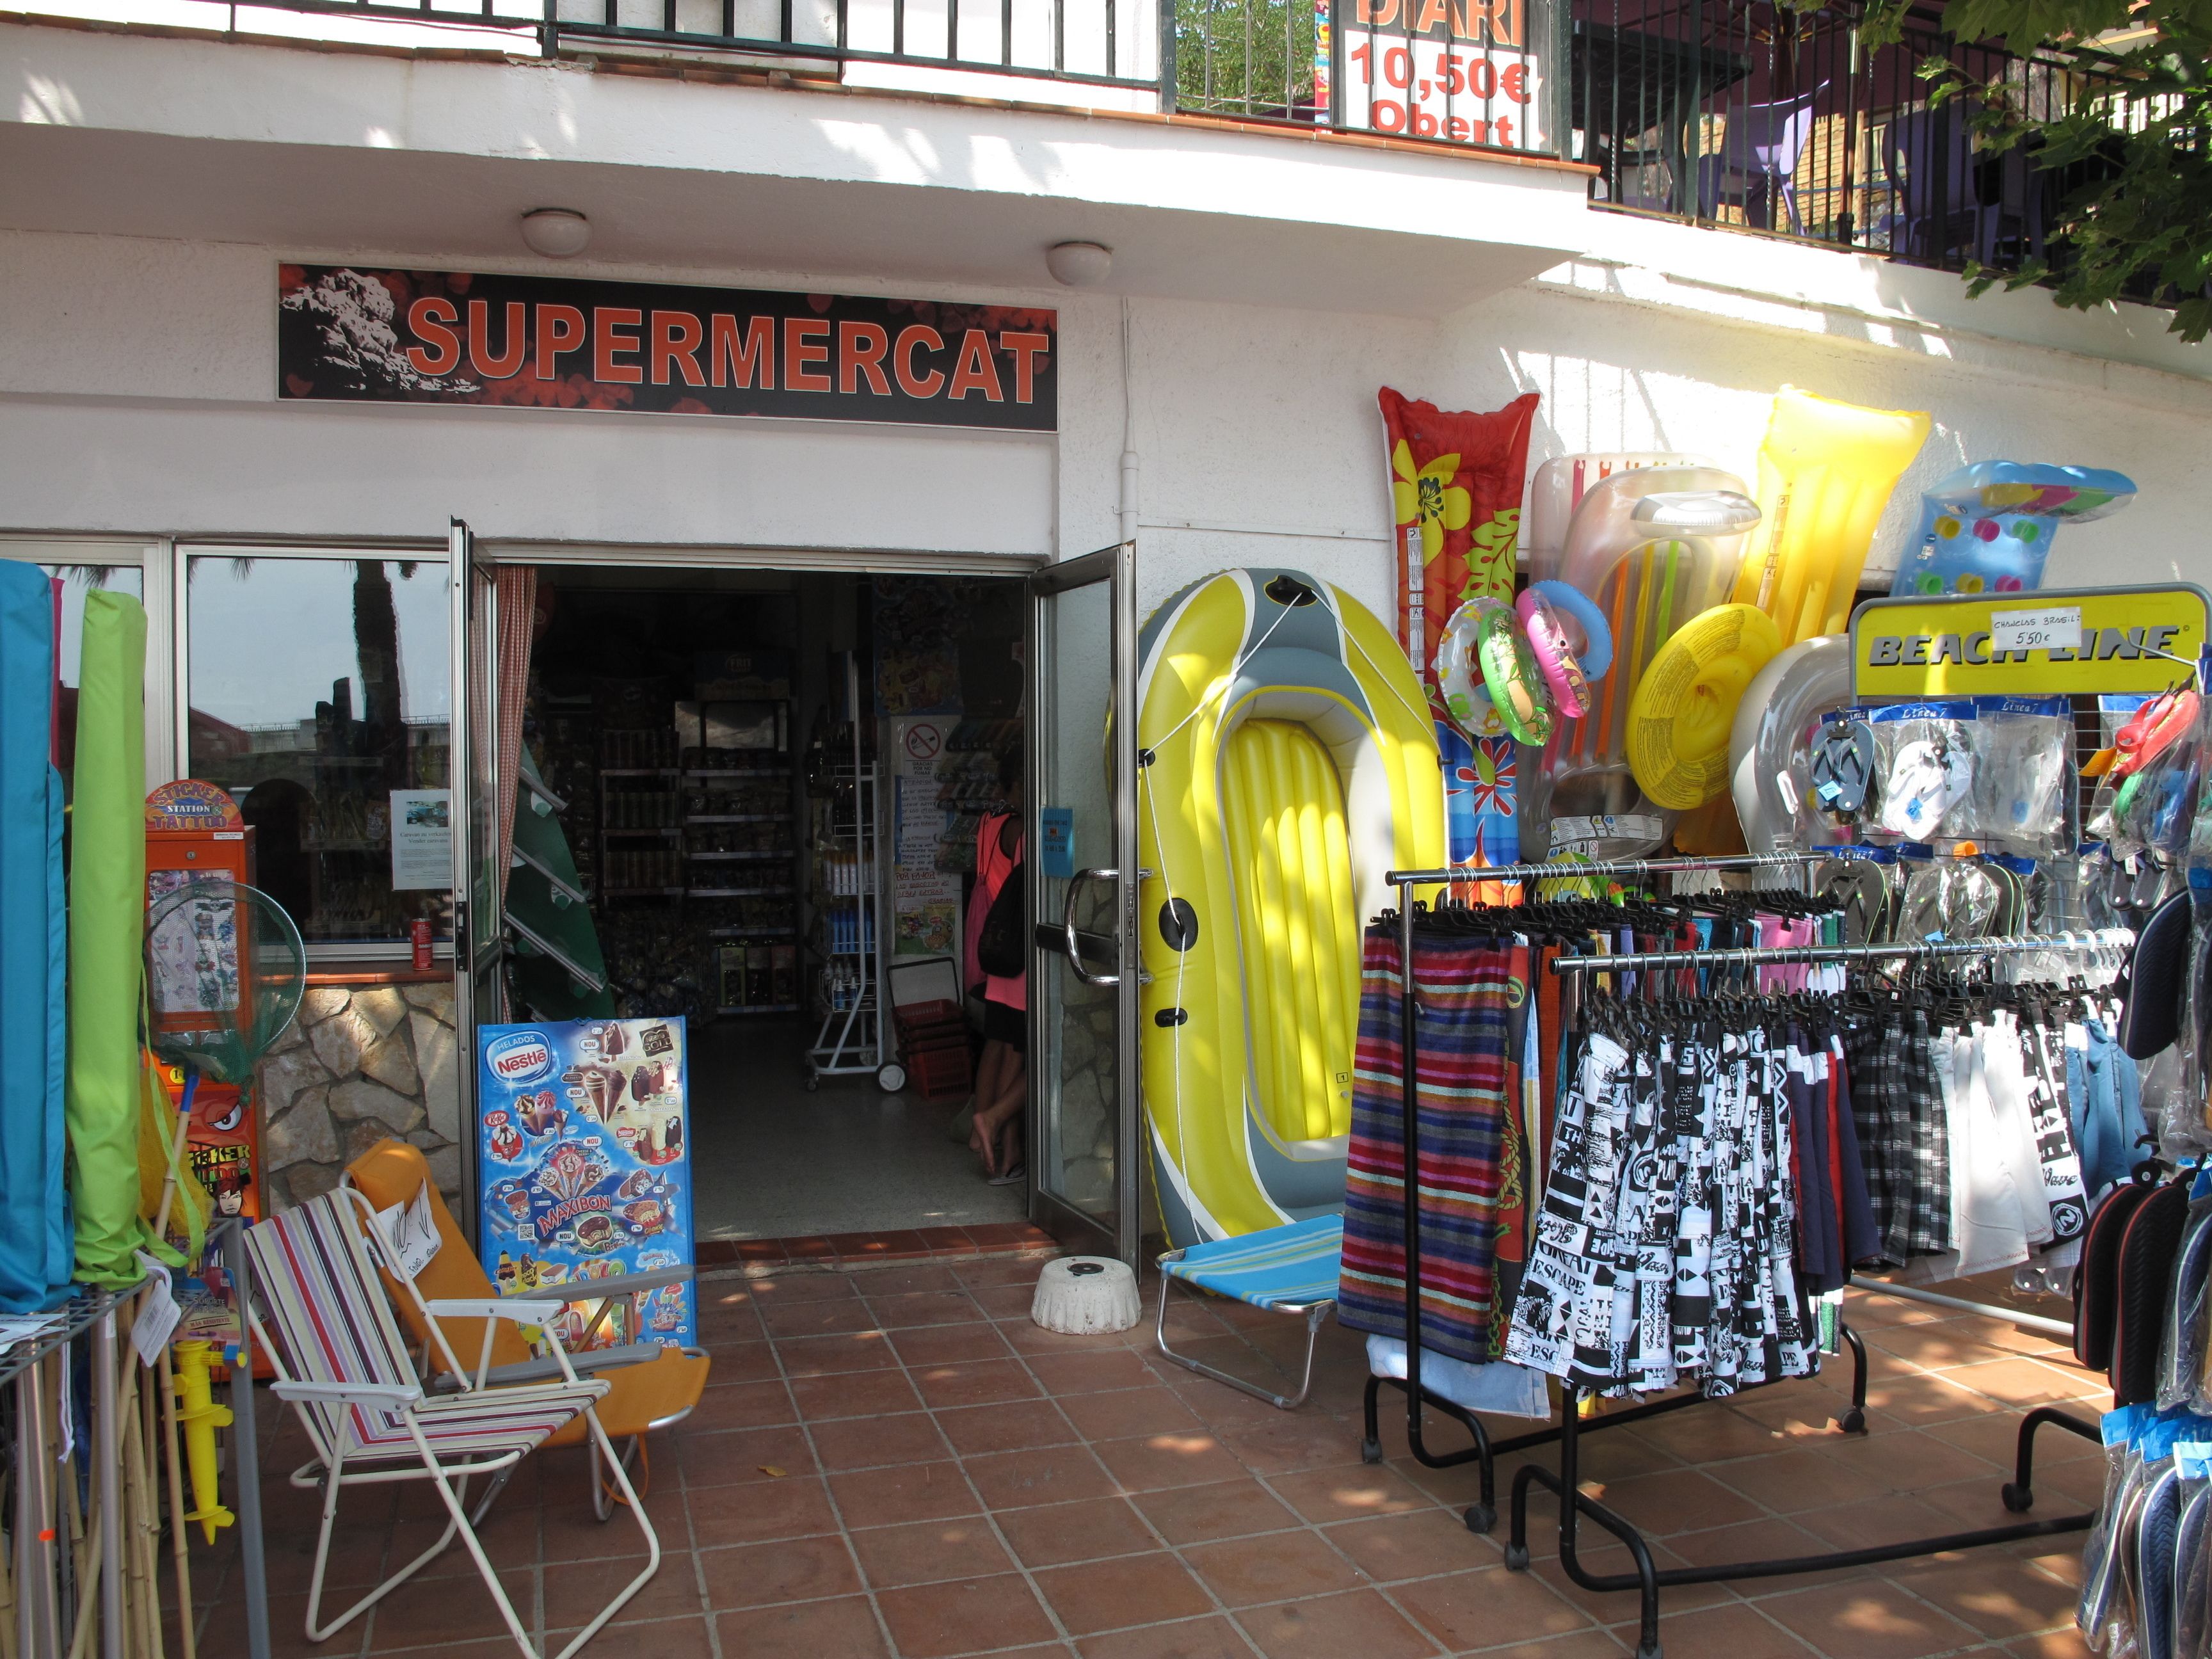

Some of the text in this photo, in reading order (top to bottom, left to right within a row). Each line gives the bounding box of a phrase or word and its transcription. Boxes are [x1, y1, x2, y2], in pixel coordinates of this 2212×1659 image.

[1351, 42, 1531, 104] 10,50€
[1372, 99, 1514, 147] Obert
[407, 296, 1050, 405] SUPERMERCAT
[1994, 618, 2035, 629] CHANCLAS
[2016, 632, 2042, 645] 5'50
[1902, 708, 1948, 719] Linea 7
[2001, 702, 2038, 712] Linea 7
[154, 783, 226, 805] STICKER
[153, 815, 228, 830] TATTOO
[497, 1035, 535, 1050] HELADOS
[497, 1048, 547, 1074] Nestlé
[538, 1195, 611, 1237] MAXIBON
[1532, 1259, 1585, 1296] ESCAPE
